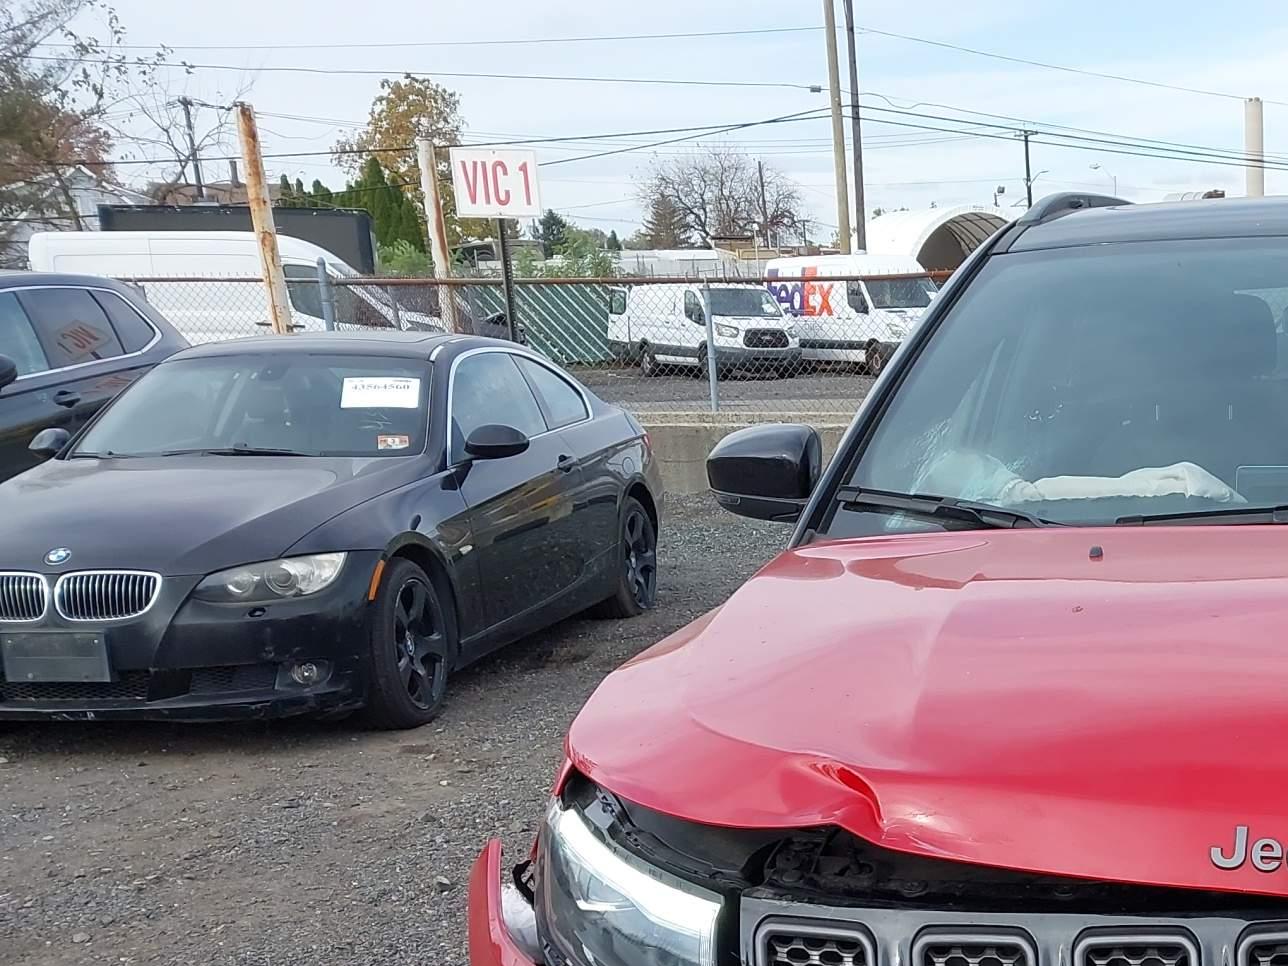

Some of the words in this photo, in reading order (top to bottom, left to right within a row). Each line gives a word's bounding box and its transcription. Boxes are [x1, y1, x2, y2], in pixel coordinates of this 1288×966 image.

[460, 160, 511, 206] VIC
[518, 161, 531, 206] 1
[767, 265, 833, 317] FedEx
